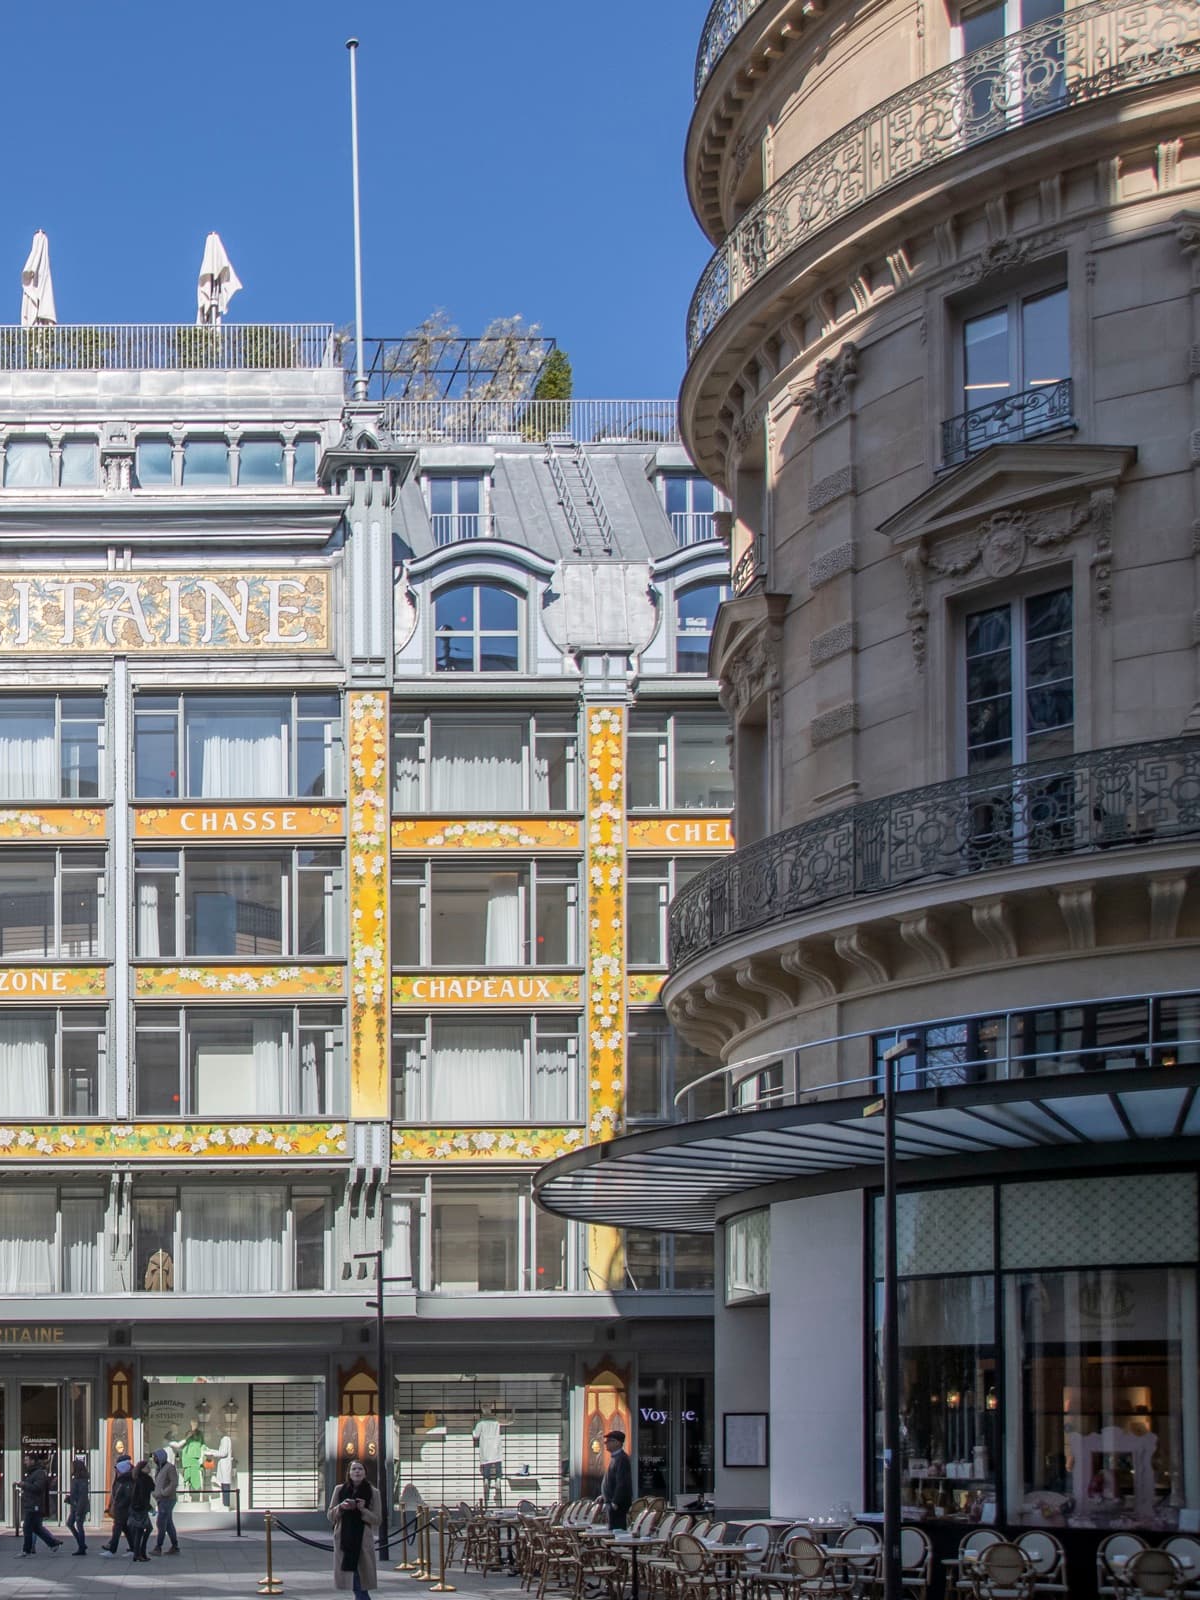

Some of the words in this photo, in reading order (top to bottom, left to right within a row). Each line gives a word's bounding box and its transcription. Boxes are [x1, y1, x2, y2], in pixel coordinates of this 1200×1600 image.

[180, 811, 298, 831] CHASSE
[665, 822, 731, 842] CHE
[412, 979, 550, 999] CHAPEAUX
[640, 1407, 699, 1425] Voye.
